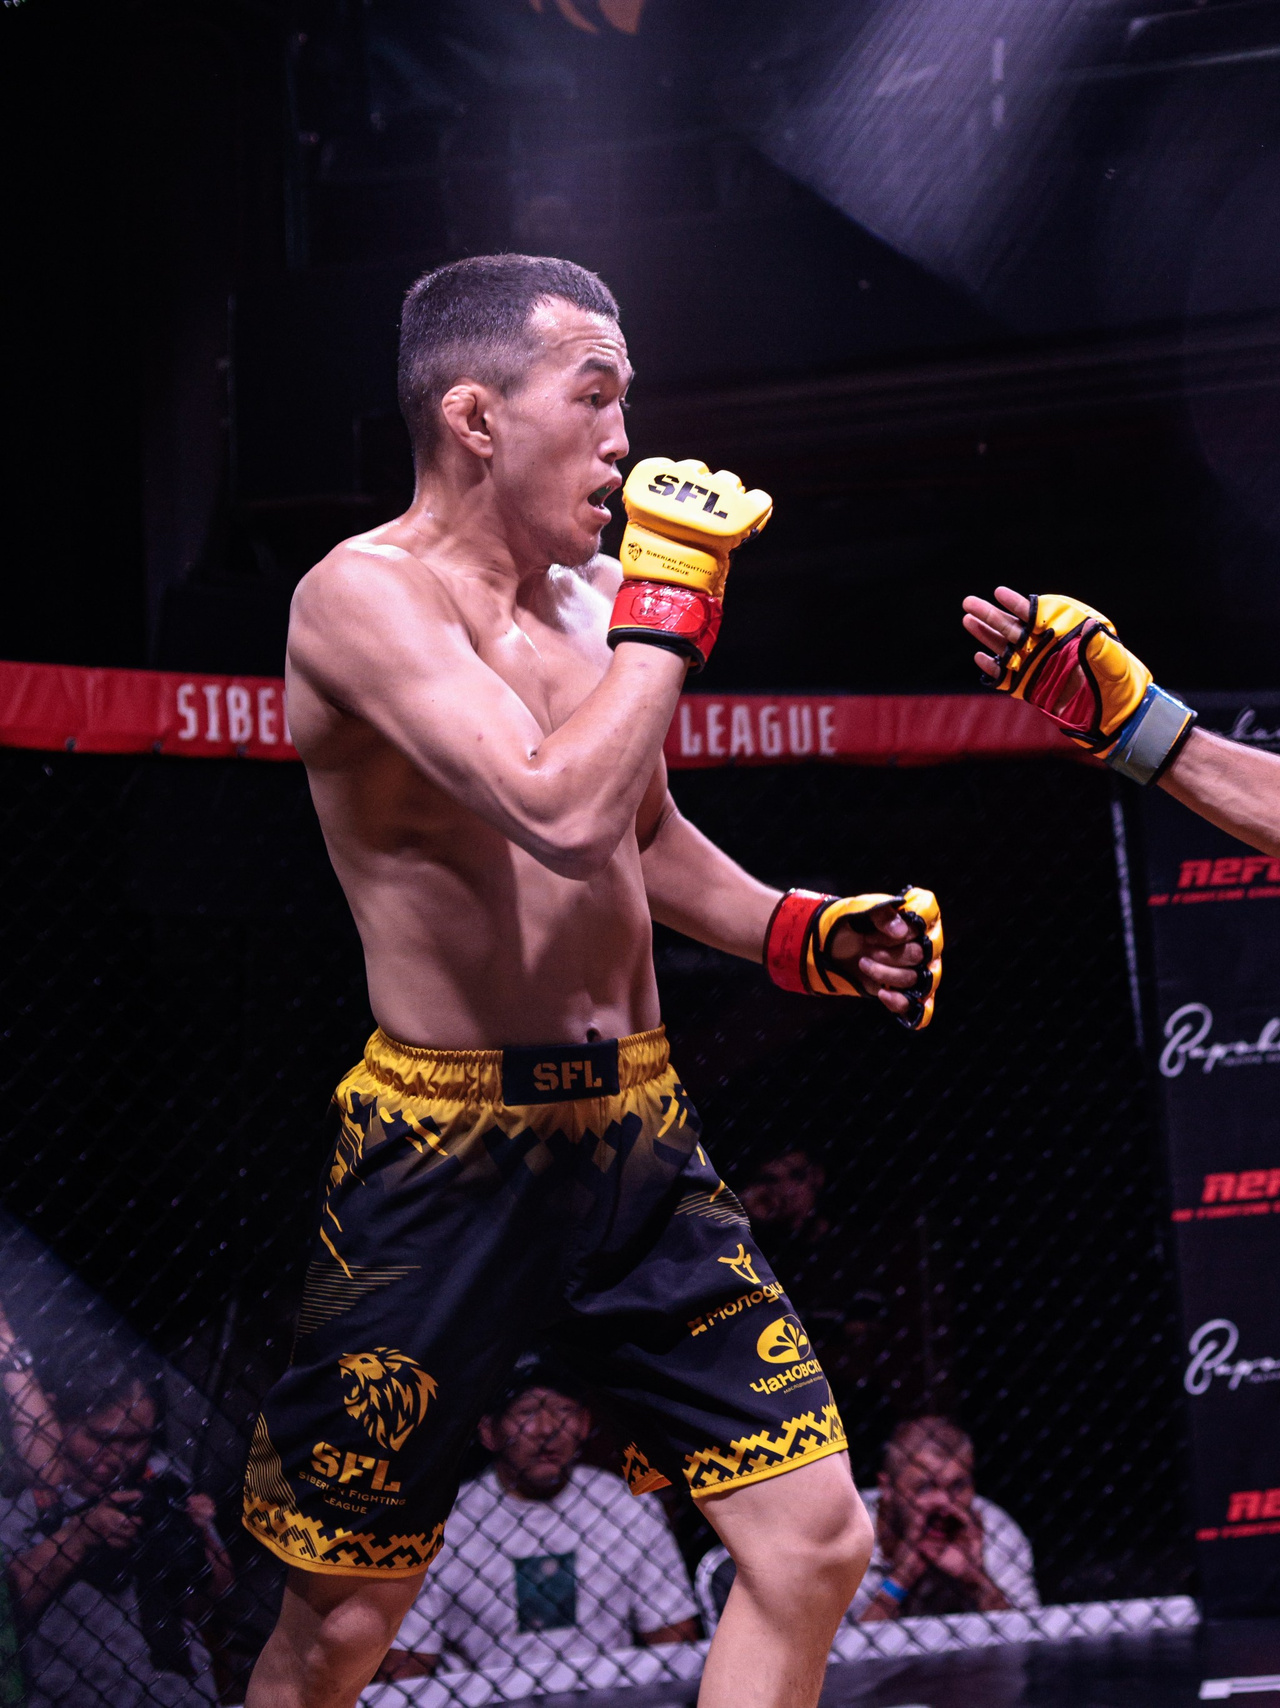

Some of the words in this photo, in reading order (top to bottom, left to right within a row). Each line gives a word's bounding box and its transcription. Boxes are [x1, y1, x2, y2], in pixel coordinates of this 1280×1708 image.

[647, 473, 729, 519] SFL
[680, 703, 838, 758] LEAGUE
[532, 1060, 603, 1091] SFL
[311, 1441, 401, 1493] SFL
[322, 1493, 368, 1515] LEAGUE
[348, 1489, 407, 1506] FIGHTING
